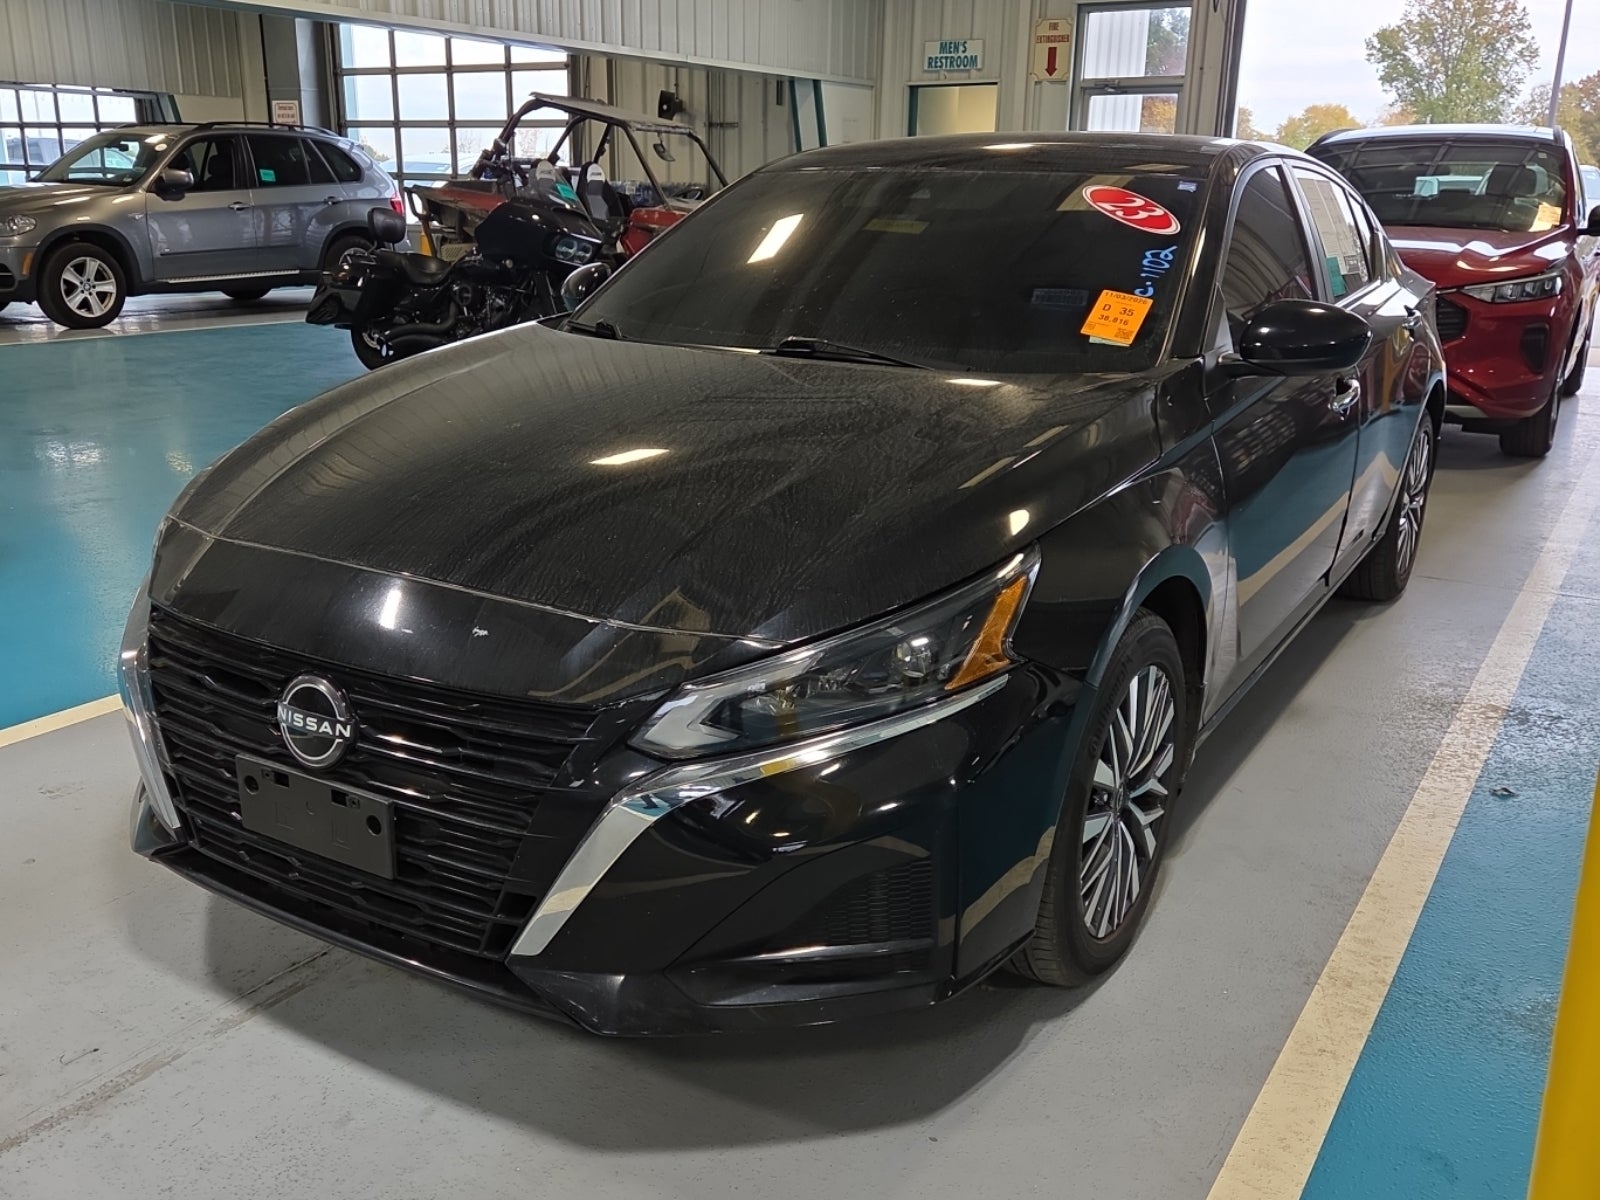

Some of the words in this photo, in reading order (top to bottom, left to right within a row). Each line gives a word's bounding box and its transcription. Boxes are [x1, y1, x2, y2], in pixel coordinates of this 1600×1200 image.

[1049, 22, 1059, 31] FIRE
[939, 41, 967, 54] MEN'S
[927, 55, 978, 68] RESTROOM
[1096, 197, 1165, 220] 23
[1119, 307, 1135, 317] 35
[277, 704, 352, 738] NISSAN
